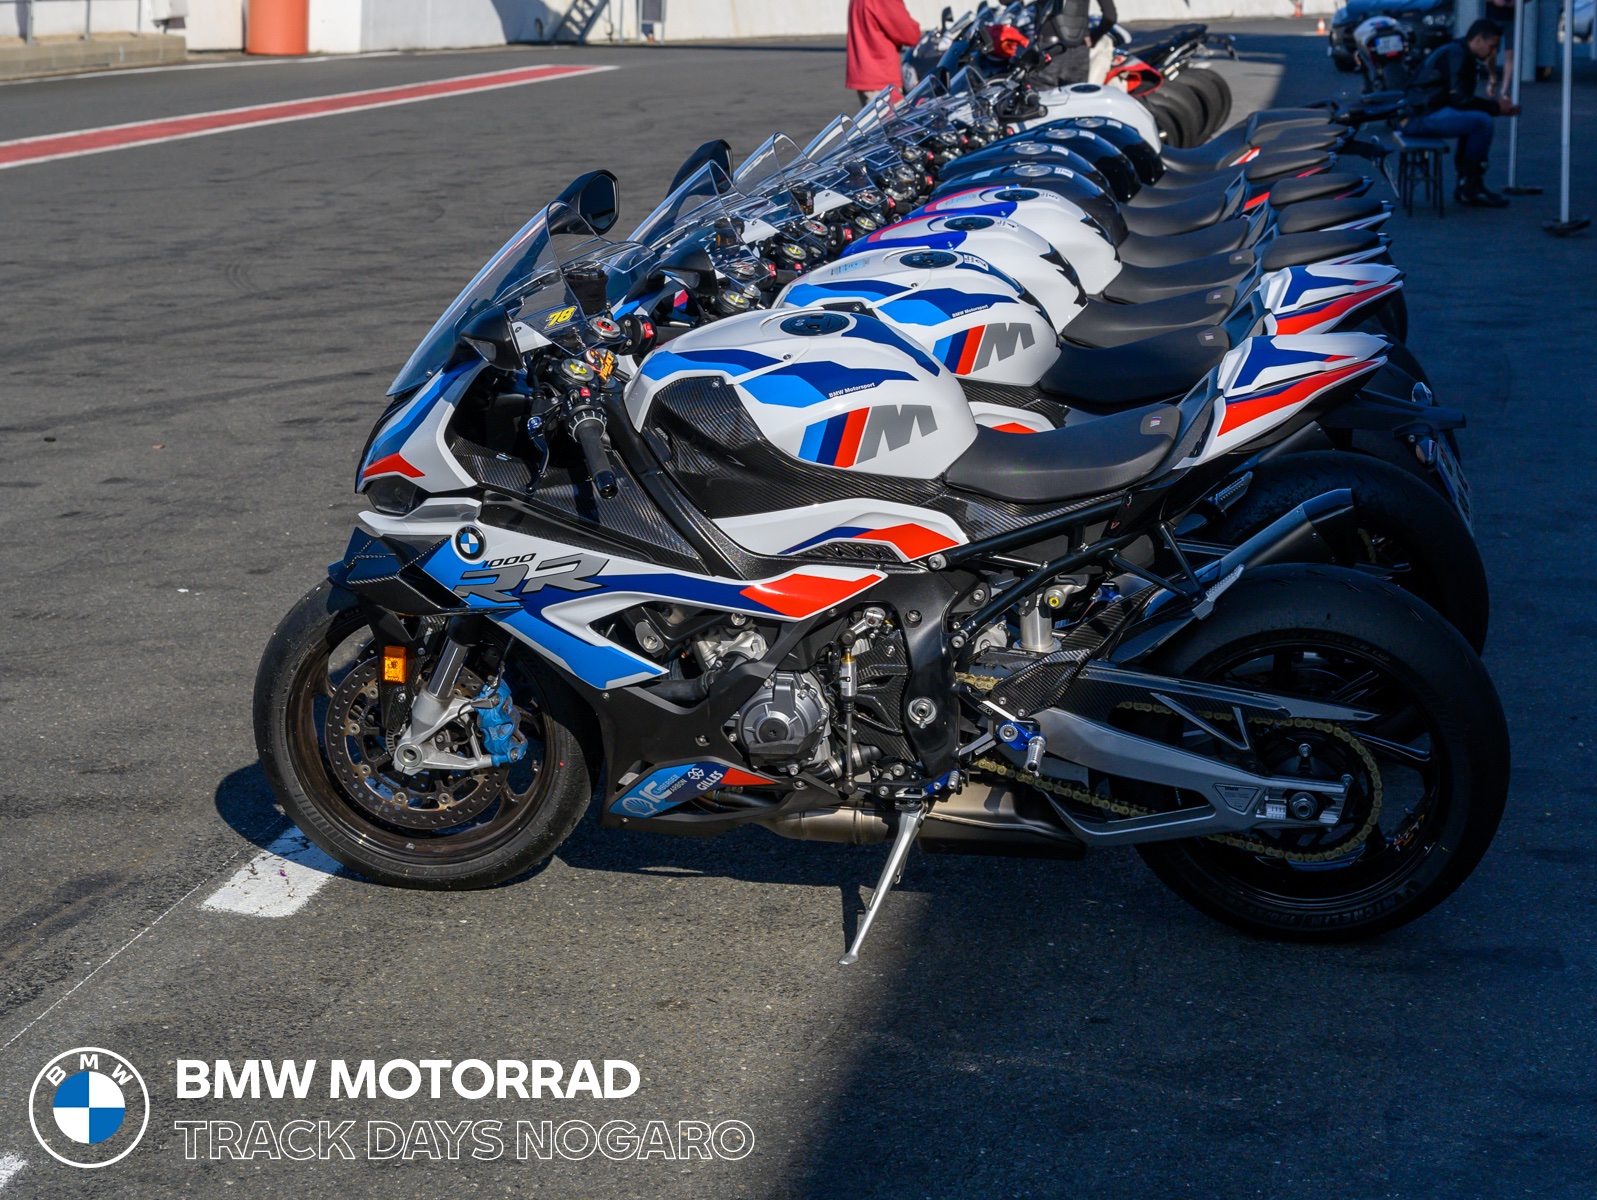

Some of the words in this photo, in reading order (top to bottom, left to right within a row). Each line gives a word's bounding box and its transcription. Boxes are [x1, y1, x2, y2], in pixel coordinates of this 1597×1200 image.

[544, 306, 577, 329] 78
[973, 323, 1035, 372] M
[828, 388, 844, 398] BMW
[844, 382, 876, 393] Motorsport
[856, 404, 938, 465] M
[482, 553, 537, 568] 1000
[453, 553, 606, 602] RR
[696, 770, 723, 790] GILLES
